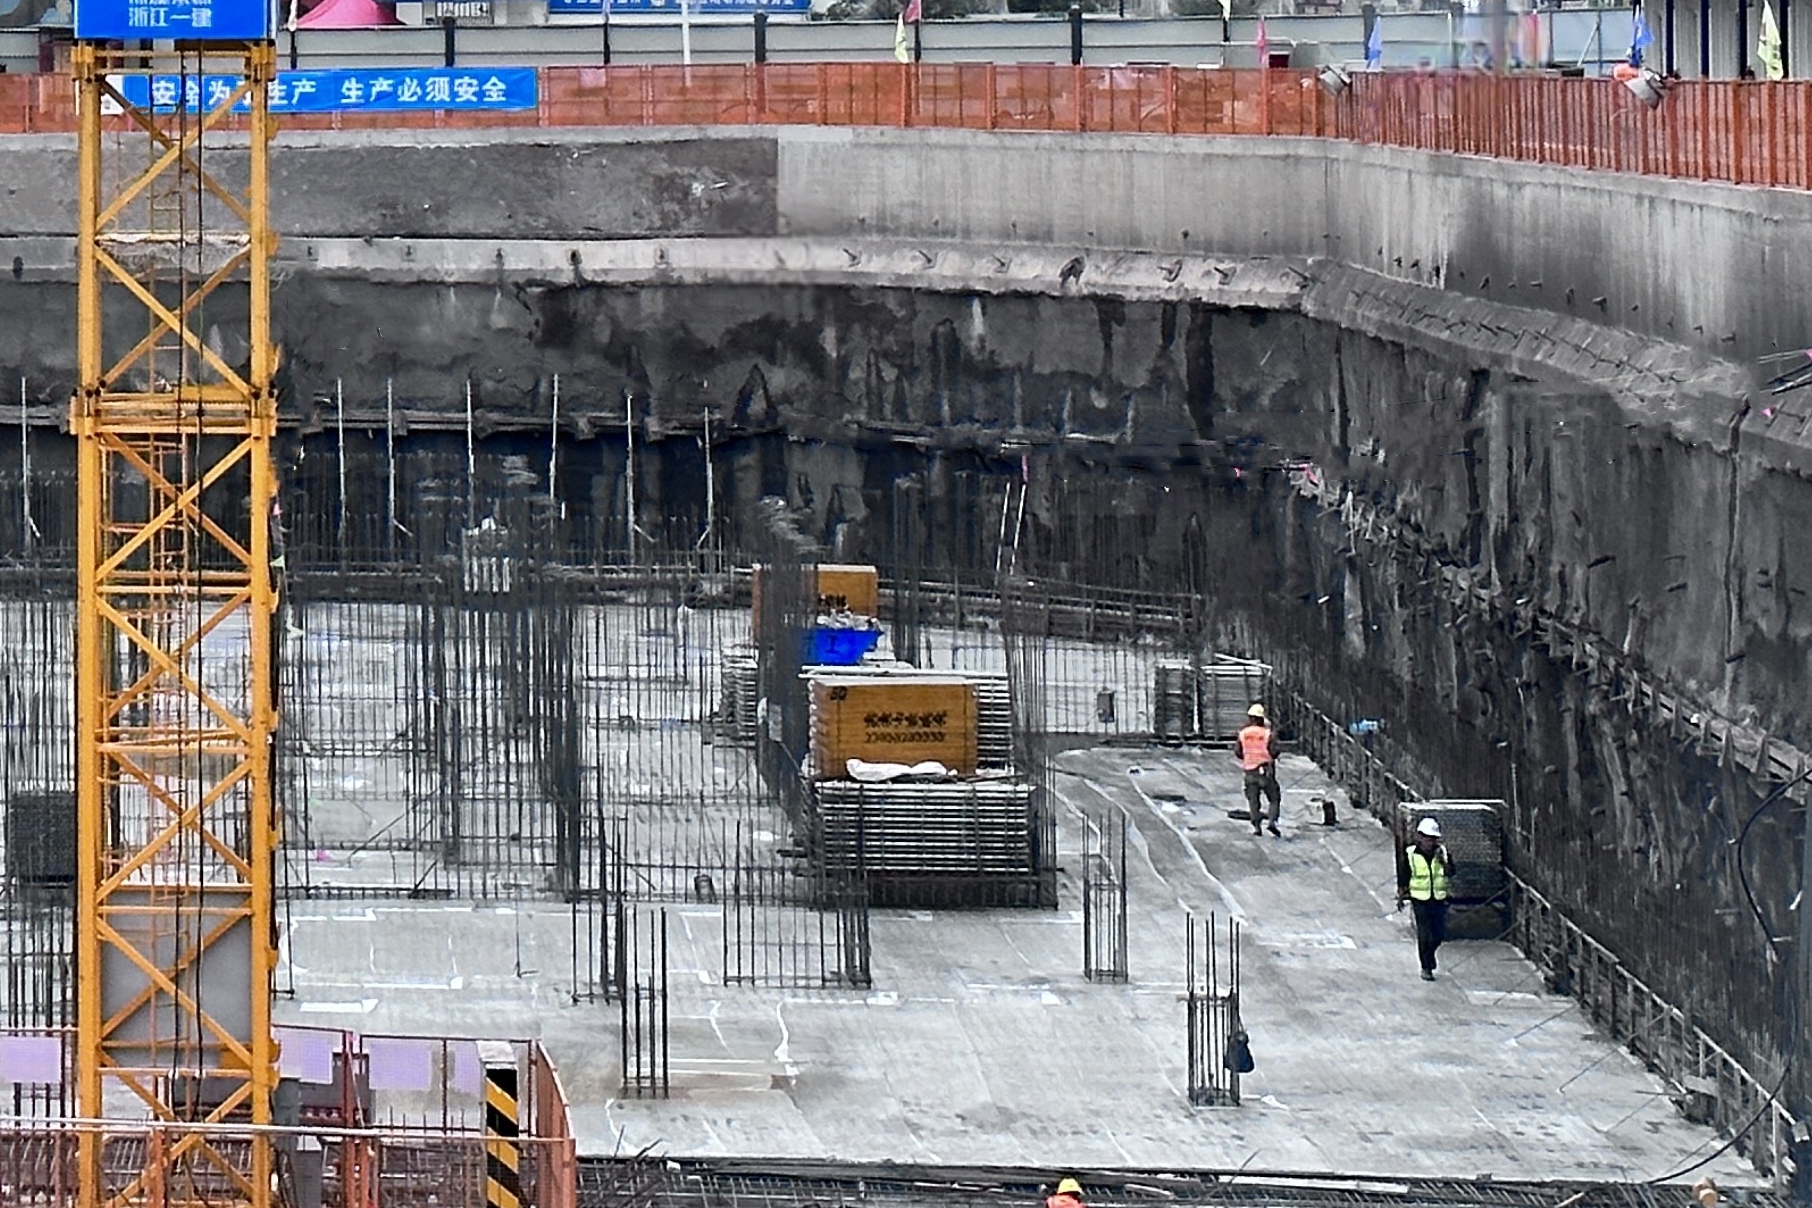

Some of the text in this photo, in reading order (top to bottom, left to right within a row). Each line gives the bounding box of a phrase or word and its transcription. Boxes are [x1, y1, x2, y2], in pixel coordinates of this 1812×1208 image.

[128, 7, 212, 27] 浙江一建
[340, 75, 508, 104] 生产必须安全
